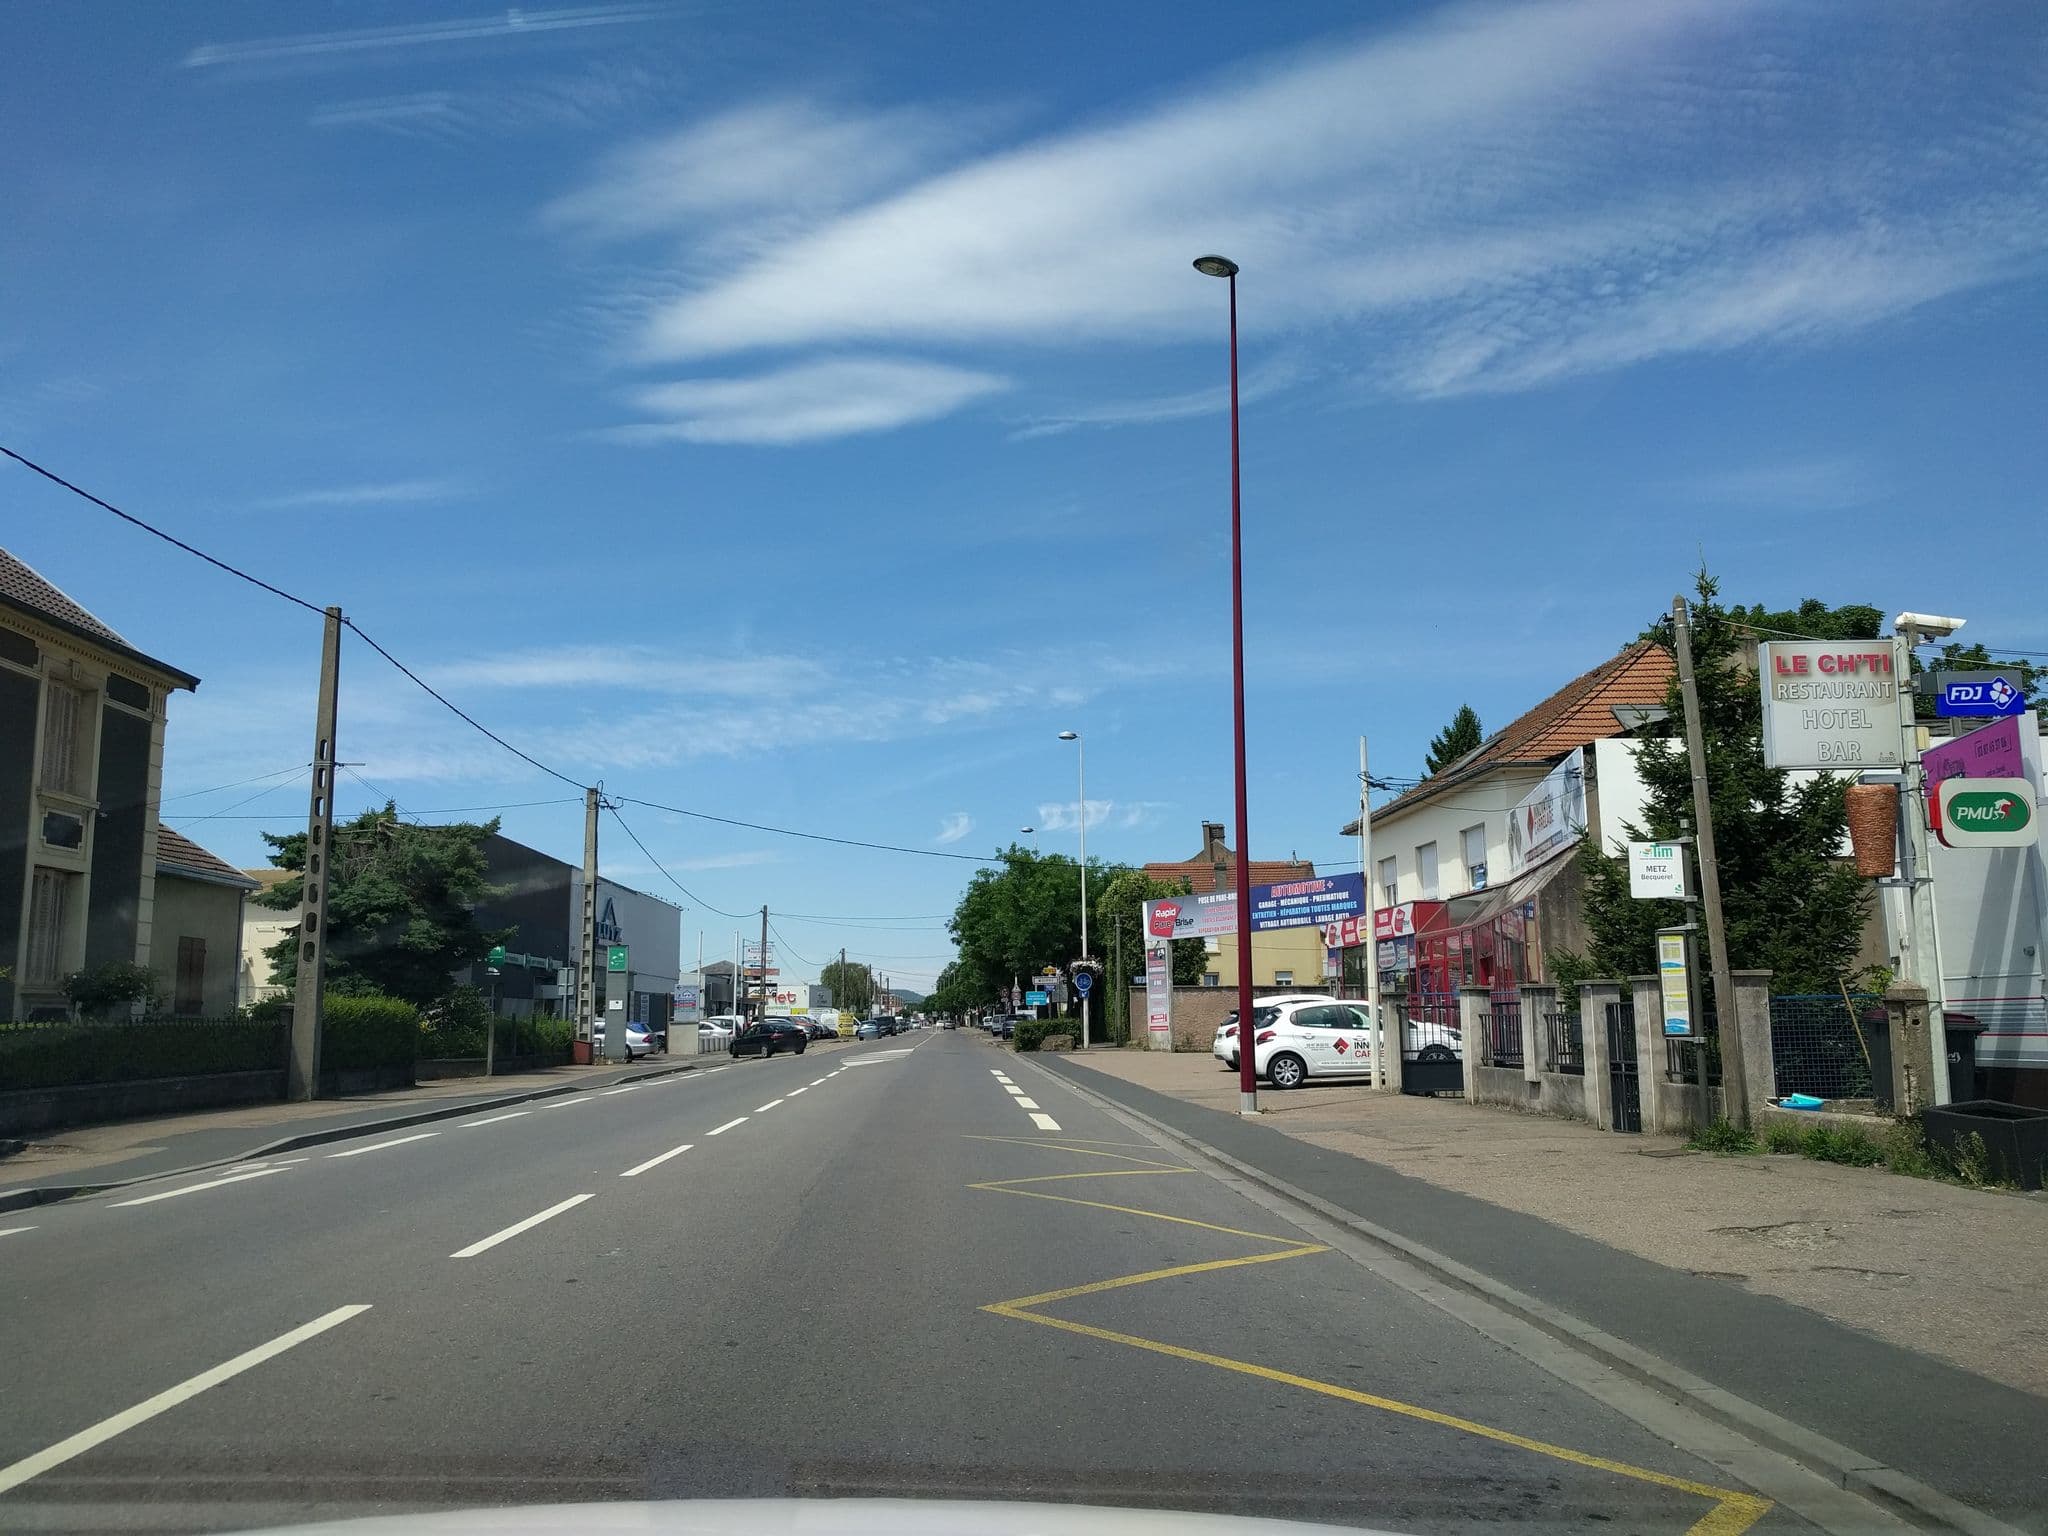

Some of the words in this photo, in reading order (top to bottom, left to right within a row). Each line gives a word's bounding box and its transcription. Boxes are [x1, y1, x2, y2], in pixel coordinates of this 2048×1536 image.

[1775, 654, 1809, 674] LE
[1777, 681, 1892, 699] RESTAURANT
[1950, 686, 1983, 701] FDJ
[1802, 709, 1872, 729] HOTEL
[1817, 741, 1862, 762] BAR
[1956, 806, 1994, 821] PMU
[1649, 843, 1673, 858] Tim
[1645, 865, 1667, 873] METZ
[1640, 873, 1673, 881] Becquerel
[1271, 880, 1326, 897] AUTOMOTIVE
[1258, 900, 1278, 909] GARAGE
[1311, 903, 1331, 913] TOUTES
[1331, 901, 1357, 912] MARQUES
[1155, 907, 1176, 919] Rapid
